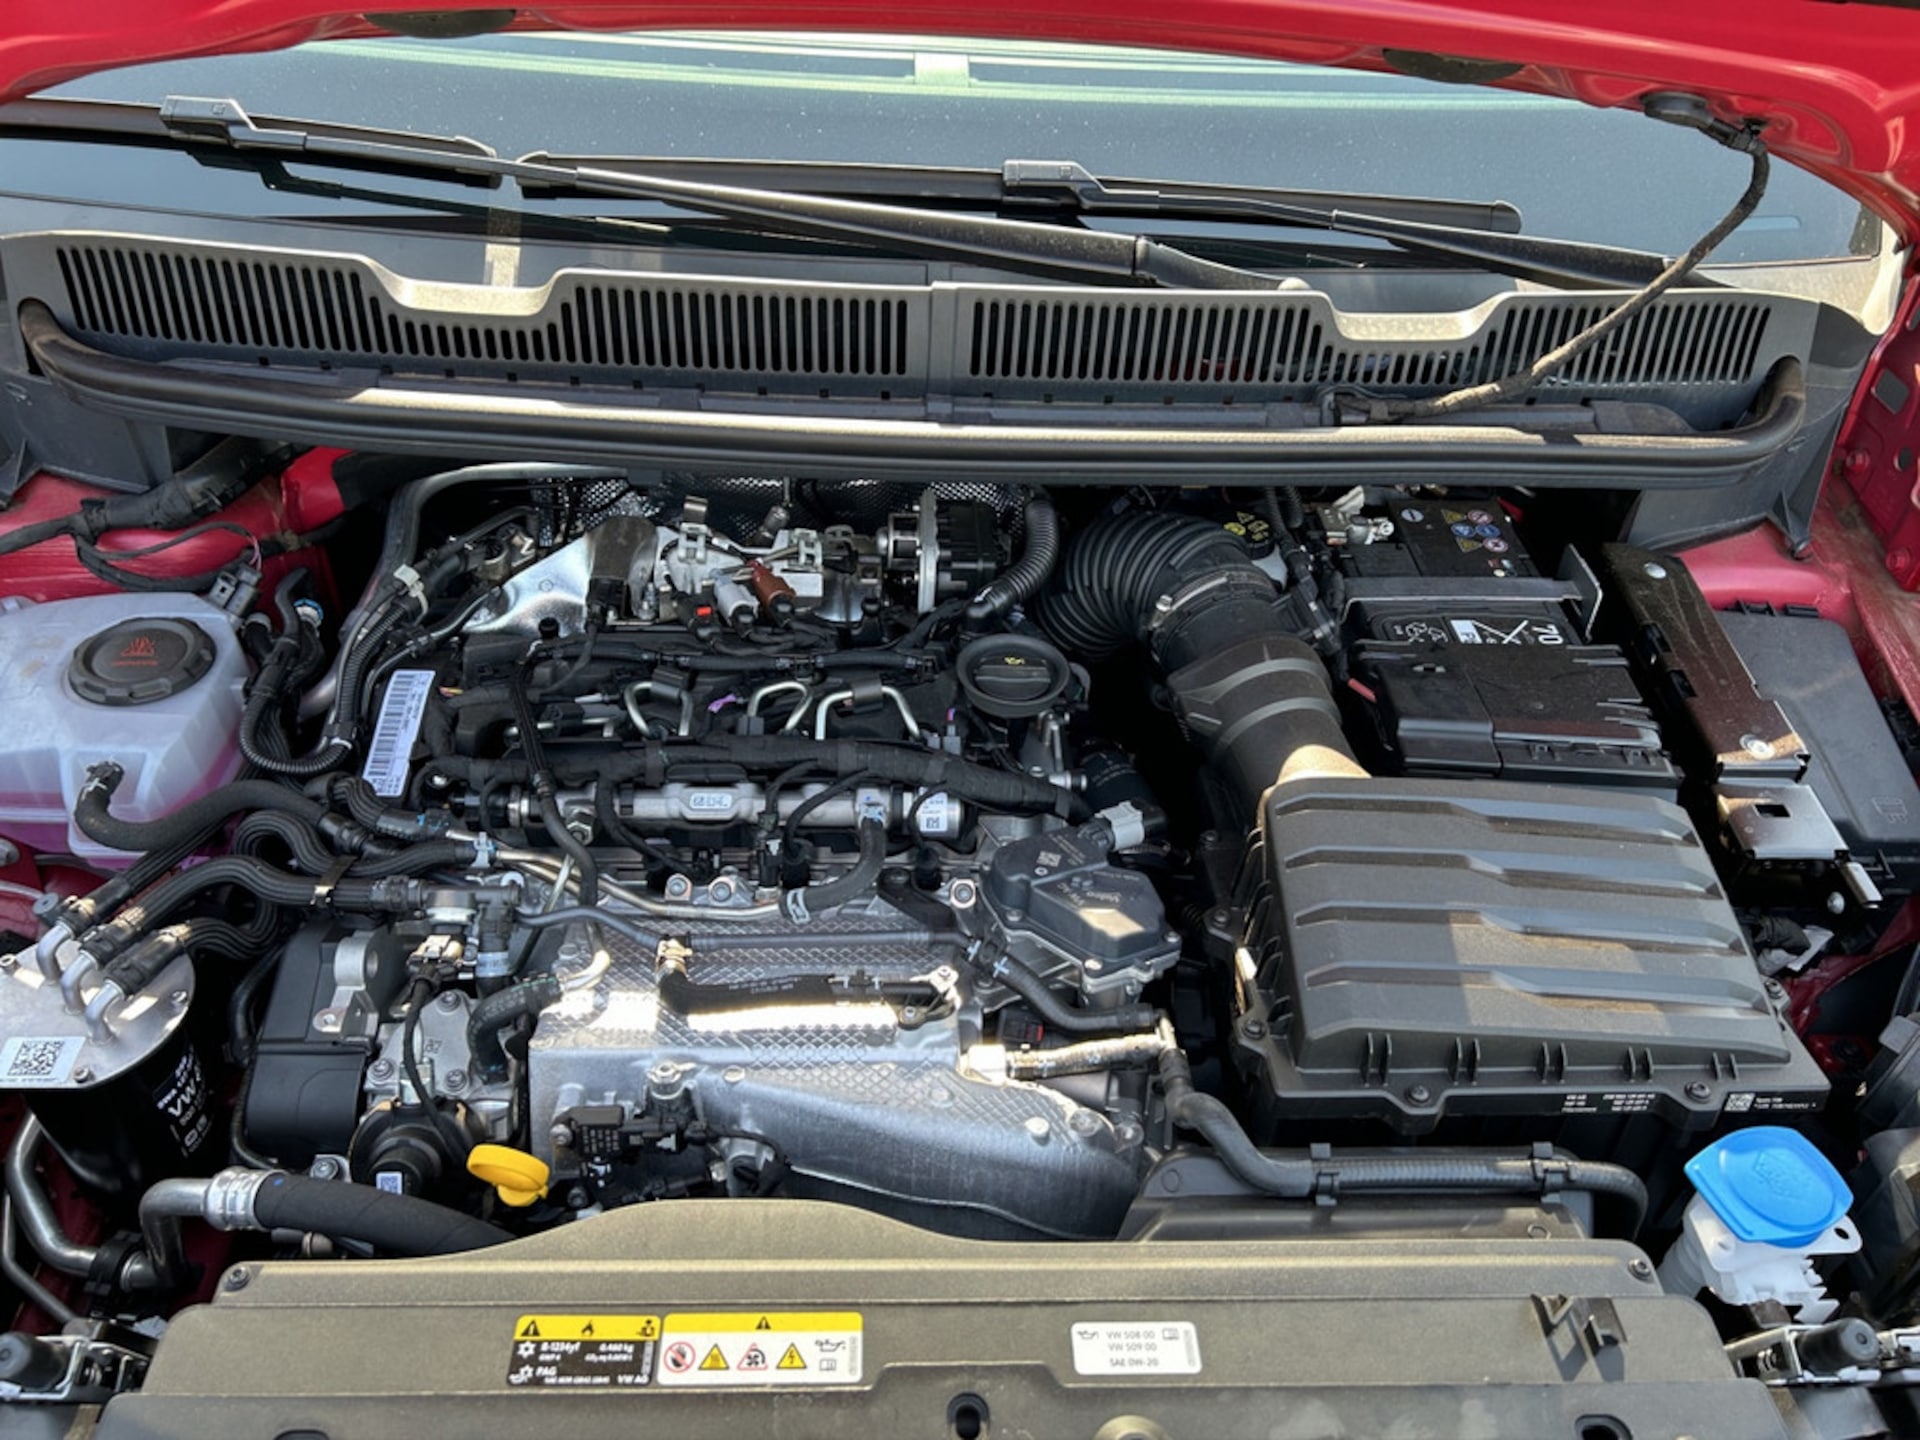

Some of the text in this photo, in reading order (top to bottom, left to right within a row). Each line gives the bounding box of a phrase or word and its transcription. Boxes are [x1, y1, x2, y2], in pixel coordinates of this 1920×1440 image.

[1532, 624, 1564, 645] 70
[536, 1366, 558, 1377] PAG
[618, 1374, 634, 1384] VW
[634, 1374, 650, 1384] AG
